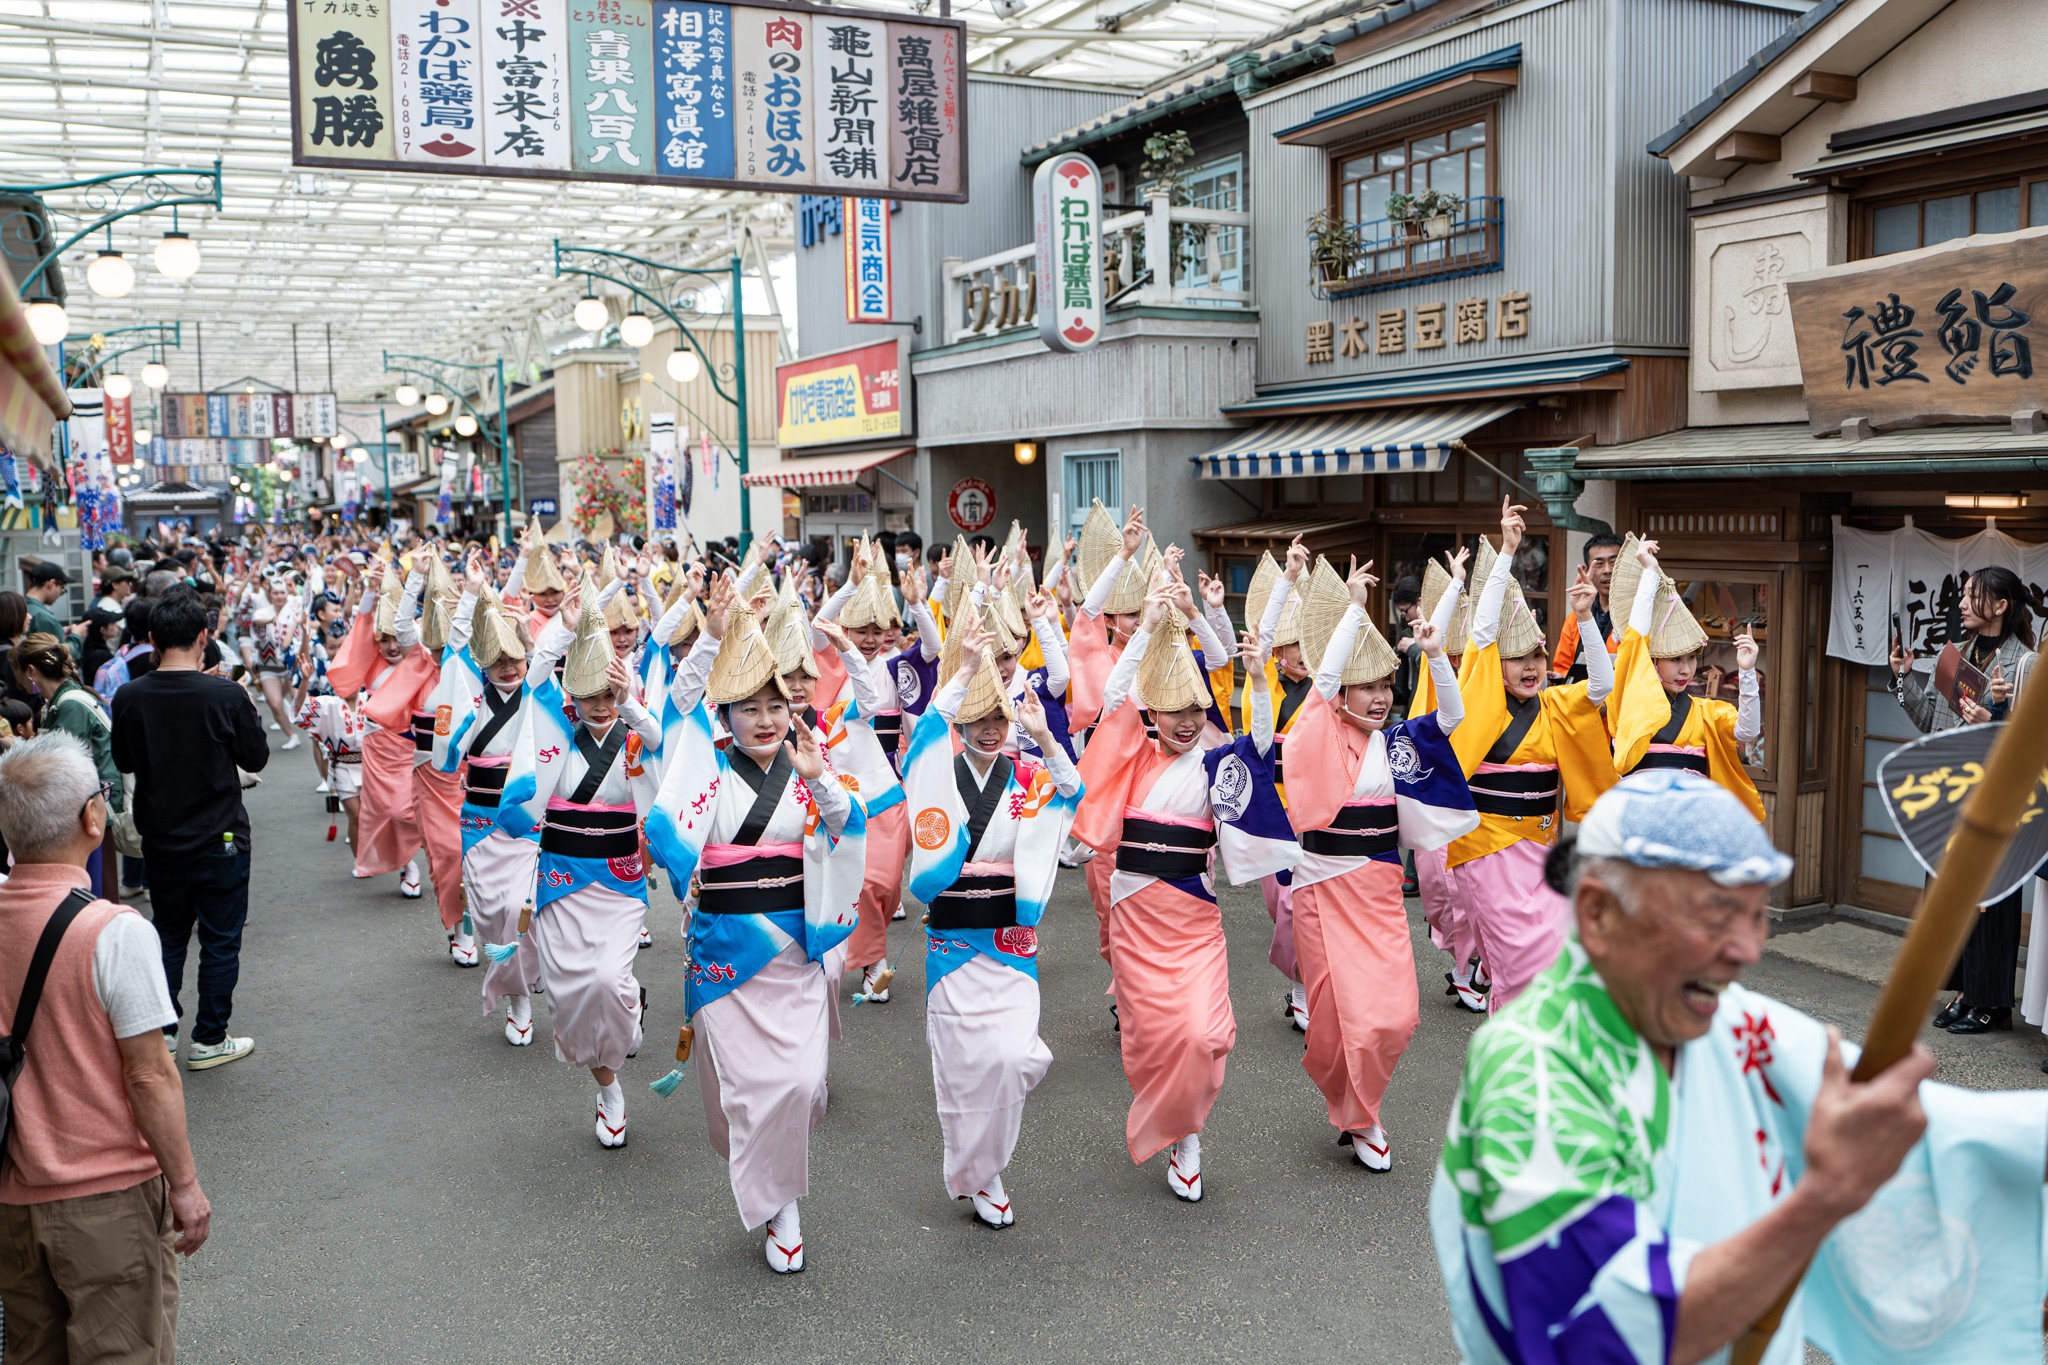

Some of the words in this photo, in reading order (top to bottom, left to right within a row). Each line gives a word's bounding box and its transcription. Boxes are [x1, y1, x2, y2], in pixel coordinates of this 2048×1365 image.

[304, 0, 380, 18] イカ焼き
[572, 10, 647, 27] とうもろこし
[707, 8, 726, 119] 記念写真なら
[310, 29, 385, 149] 魚勝
[492, 19, 556, 158] 中富米店
[764, 14, 806, 177] 肉のおほみ
[788, 373, 857, 427] けやき電気商会
